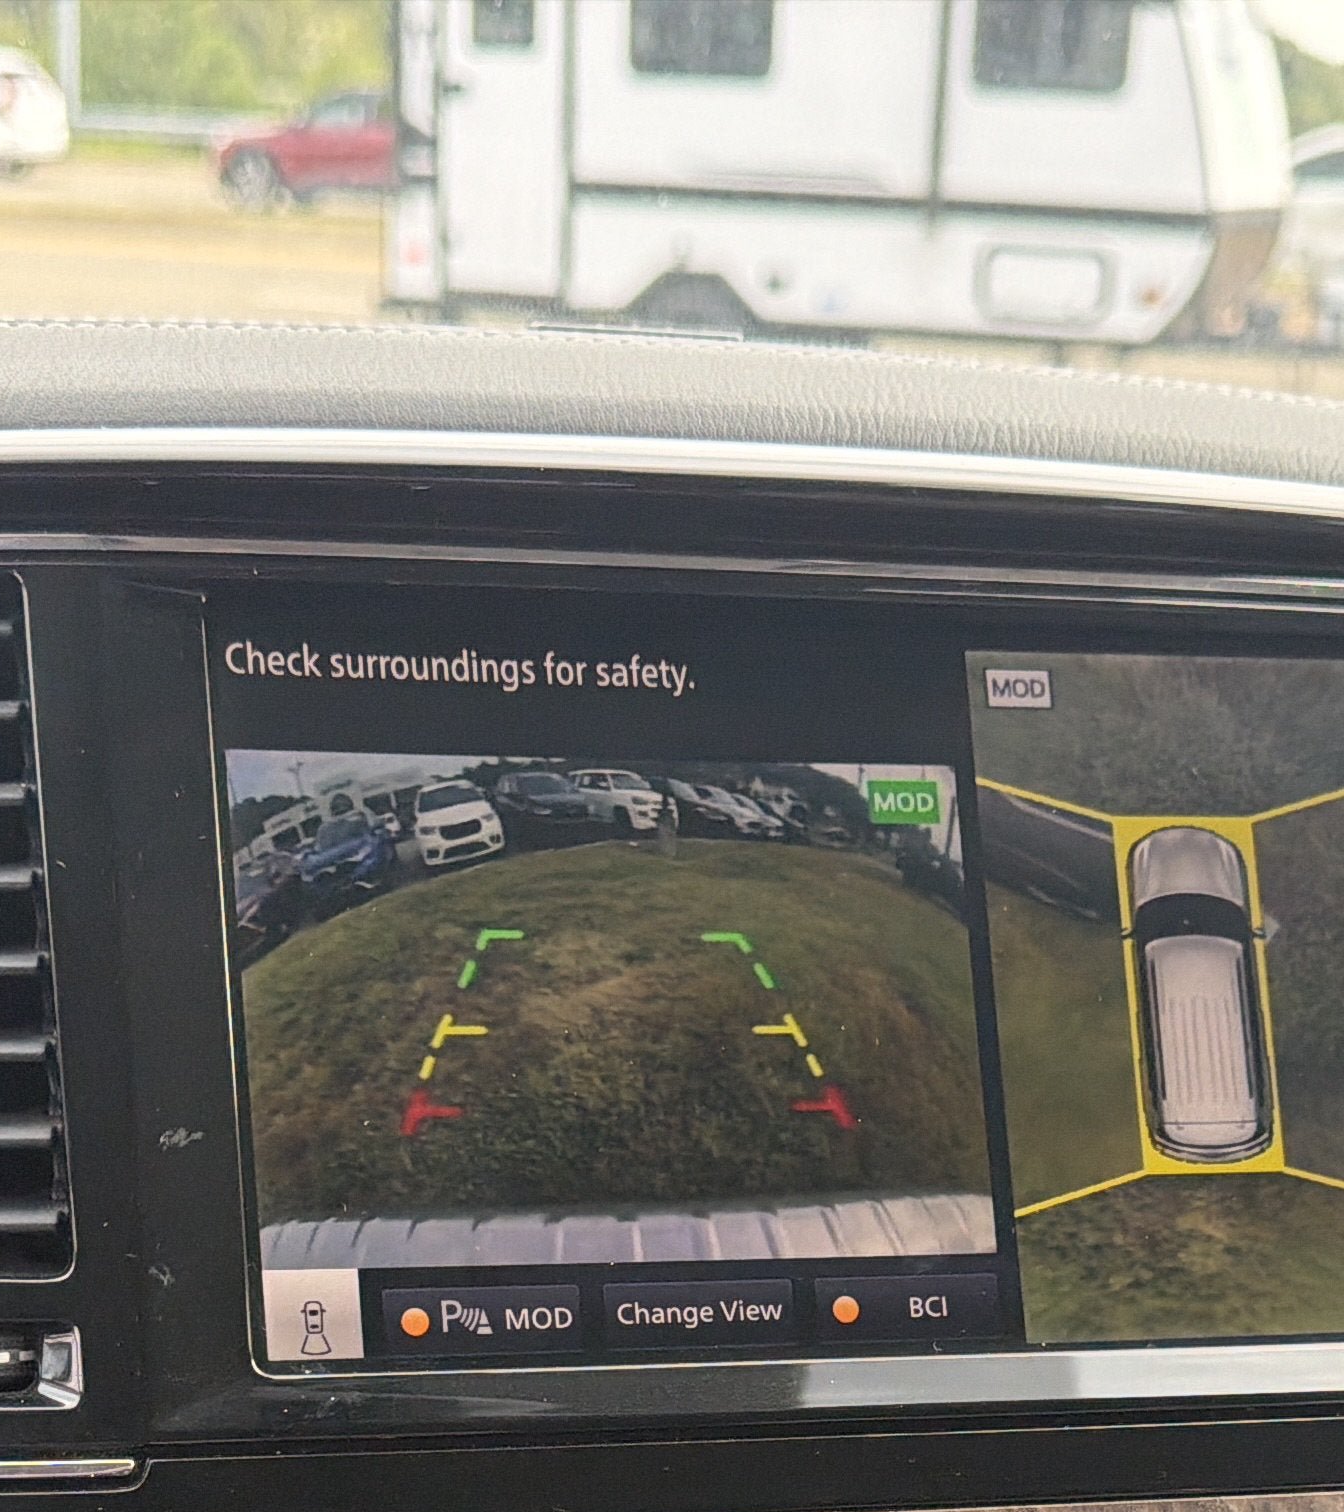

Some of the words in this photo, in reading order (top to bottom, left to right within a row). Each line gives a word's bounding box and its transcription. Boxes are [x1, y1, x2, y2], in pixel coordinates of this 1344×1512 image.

[224, 640, 323, 678] Check
[329, 648, 536, 692] surroundings
[543, 651, 587, 687] for
[595, 654, 697, 697] safety.
[990, 675, 1046, 701] MOD
[872, 790, 935, 814] MOD
[505, 1306, 573, 1331] MOD
[616, 1299, 714, 1329] Change
[720, 1298, 783, 1325] View
[908, 1294, 949, 1319] BCI
